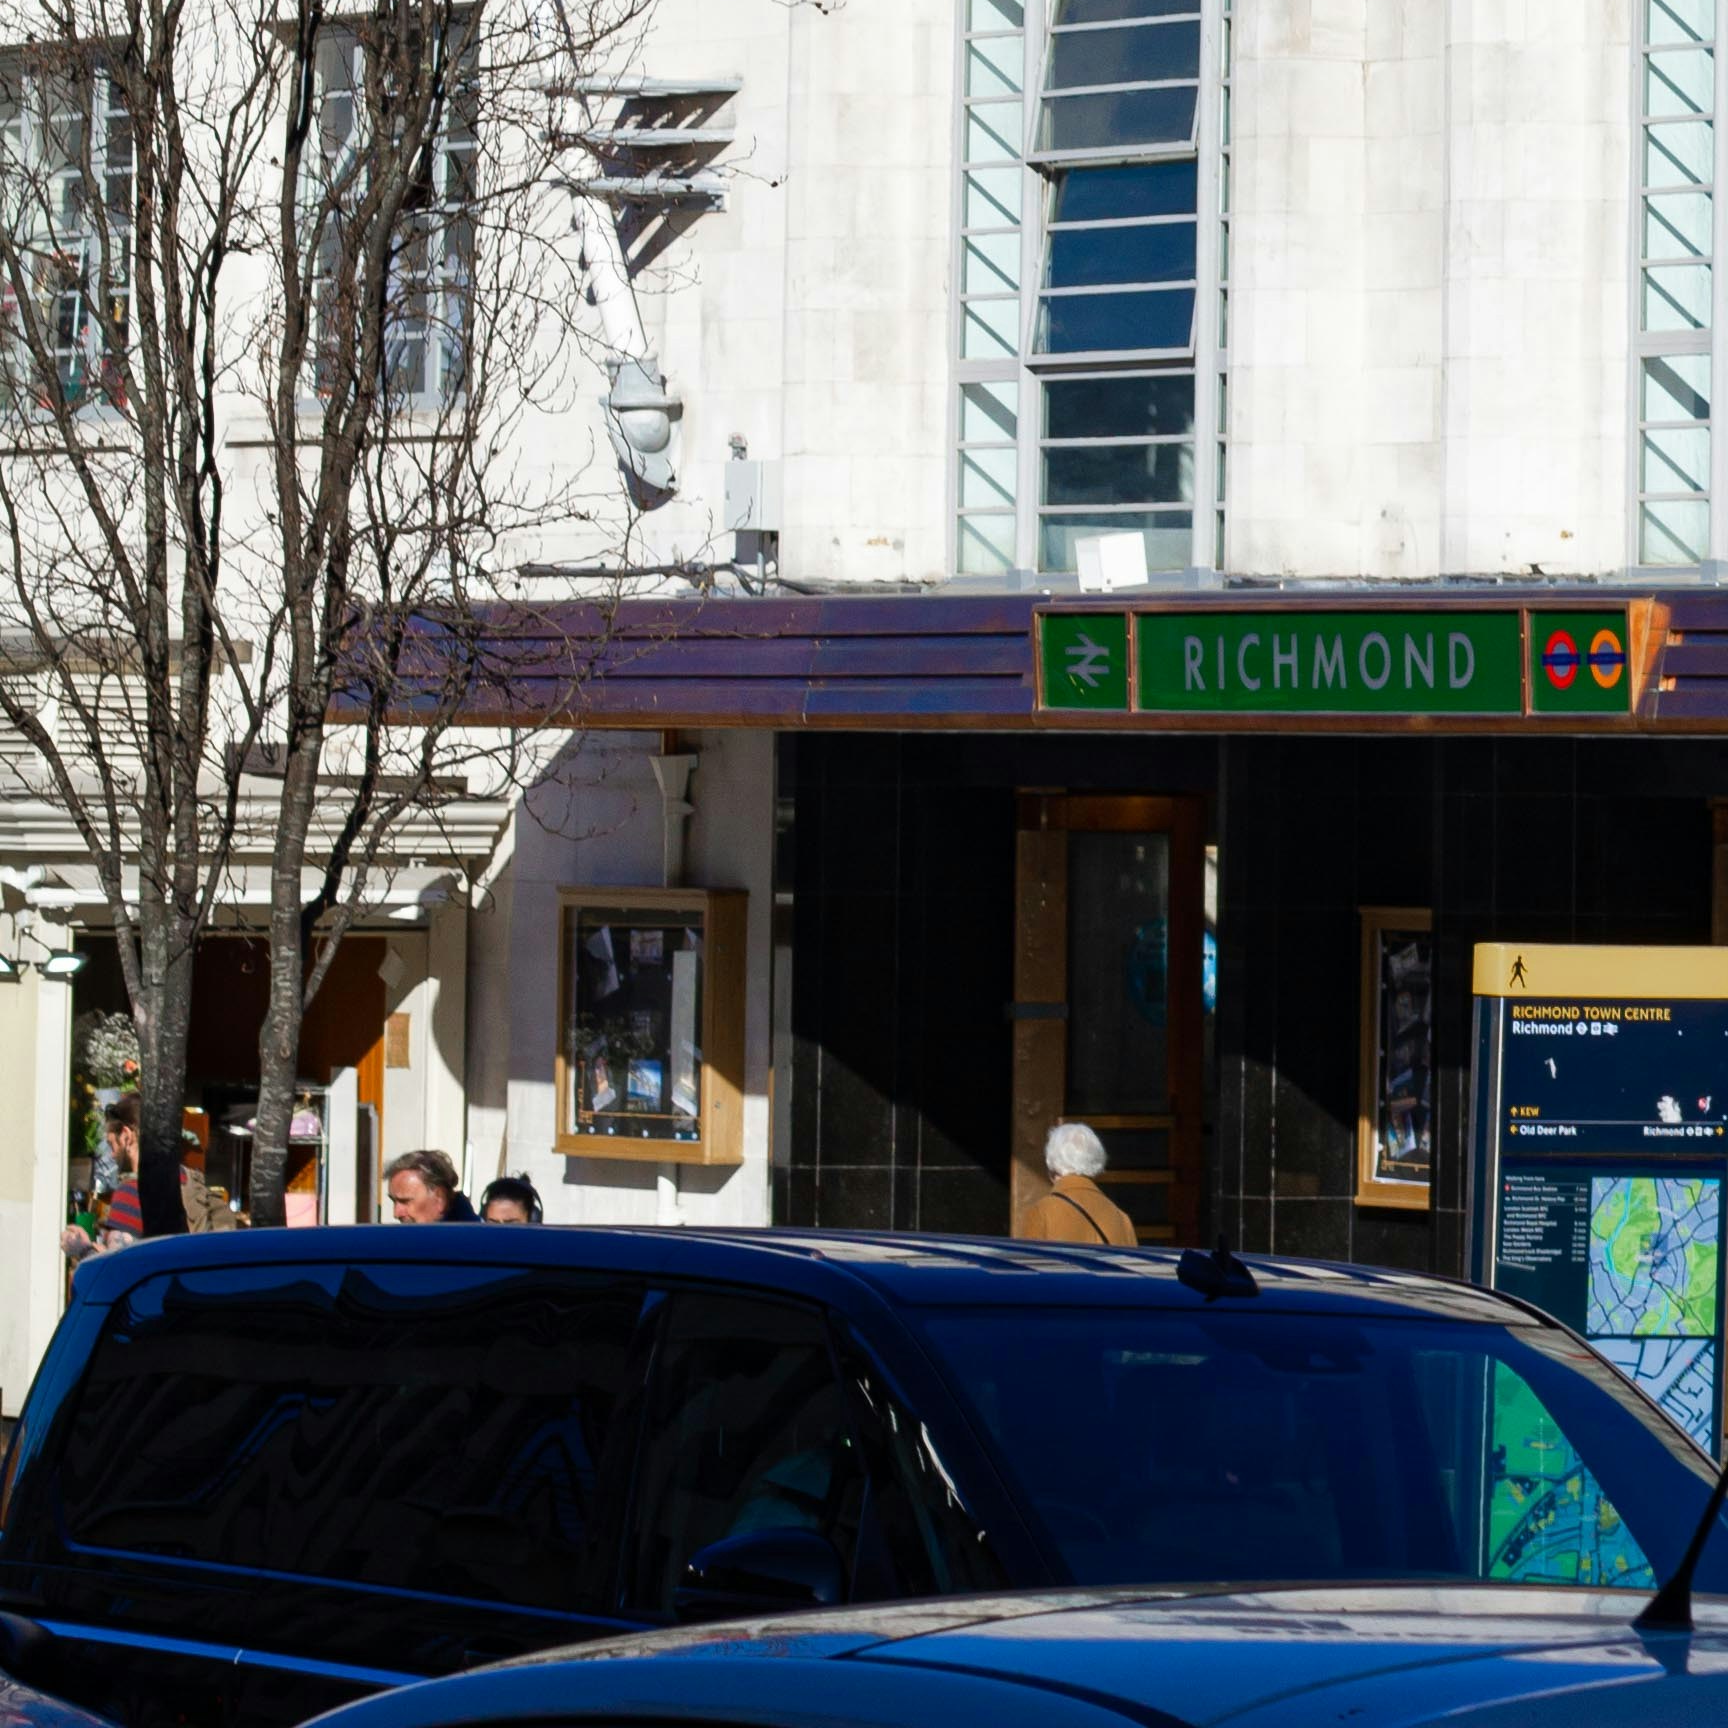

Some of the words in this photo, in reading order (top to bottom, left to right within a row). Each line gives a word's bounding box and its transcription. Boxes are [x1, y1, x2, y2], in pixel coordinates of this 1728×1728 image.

[1183, 631, 1476, 691] RICHMOND
[1512, 1005, 1580, 1020] RICHMOND
[1583, 1006, 1621, 1020] TOWN
[1624, 1007, 1671, 1021] CENTRE
[1512, 1020, 1573, 1035] Richmond
[1520, 1106, 1540, 1117] KEW
[1519, 1124, 1535, 1136] Old
[1537, 1125, 1557, 1136] Deer
[1558, 1125, 1577, 1136] Park
[1643, 1126, 1685, 1137] Richmond
